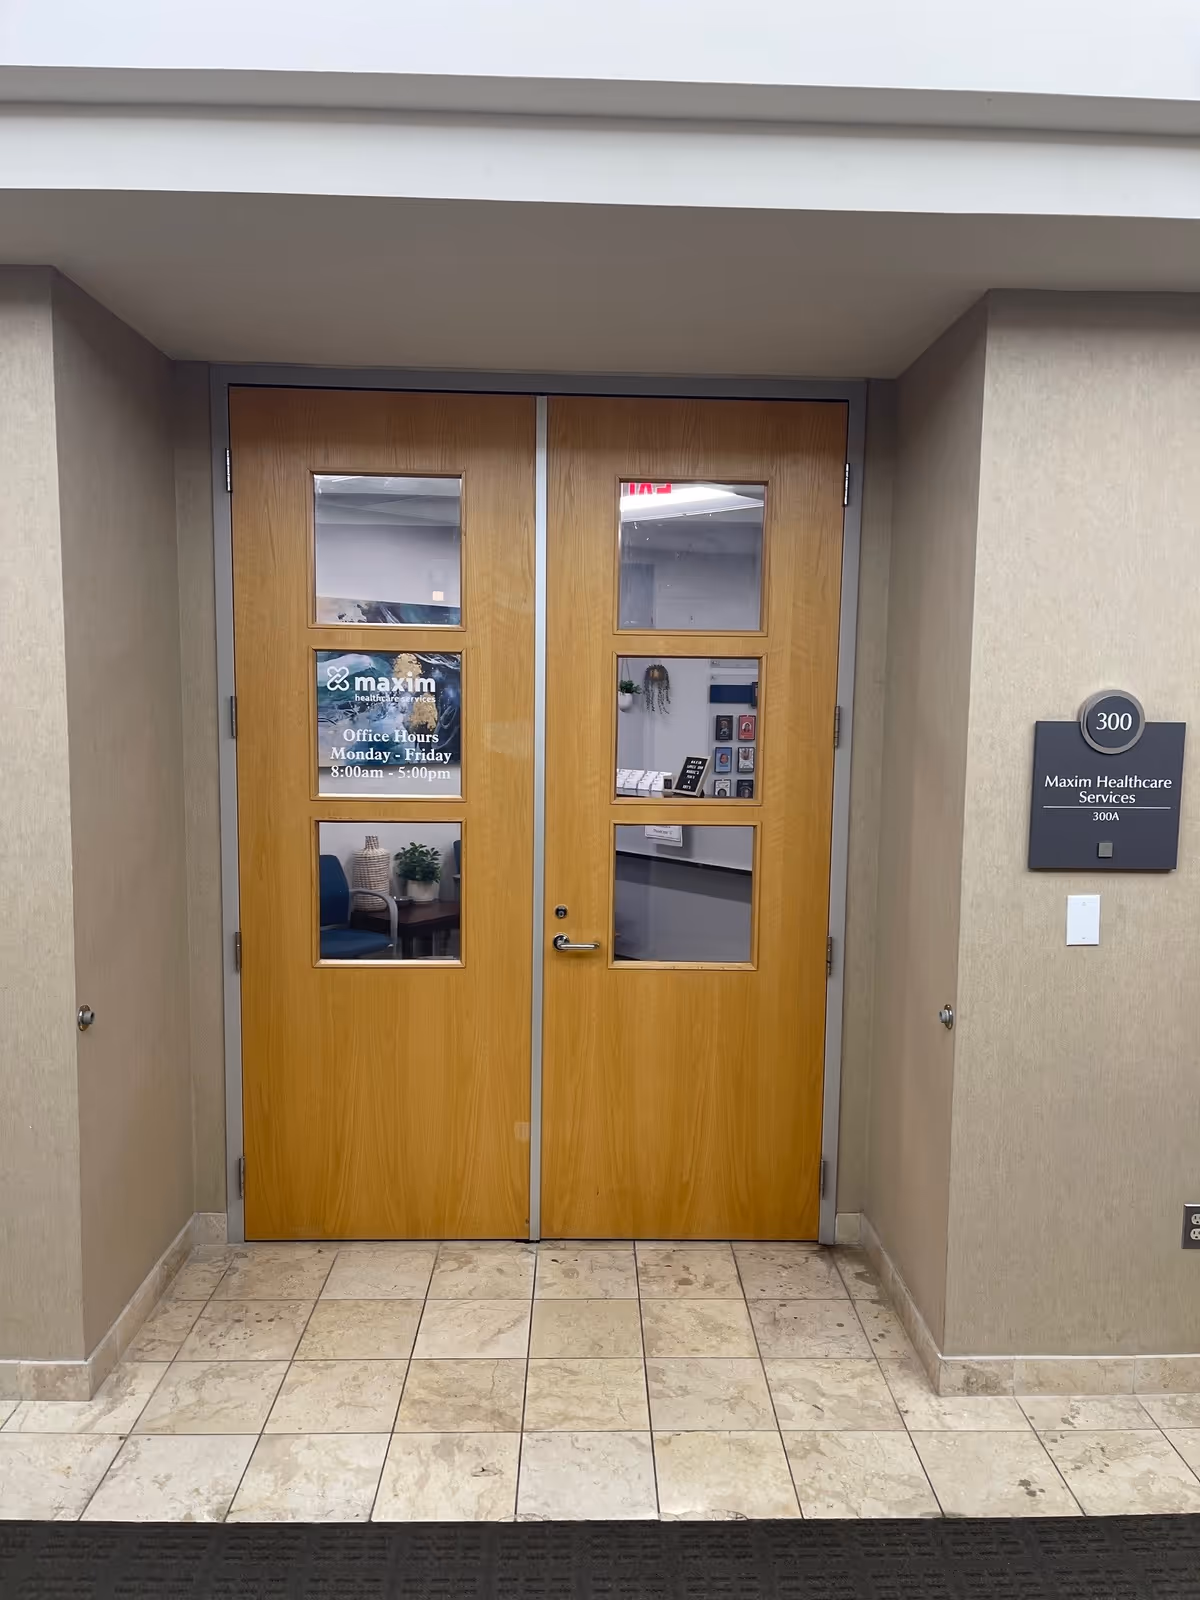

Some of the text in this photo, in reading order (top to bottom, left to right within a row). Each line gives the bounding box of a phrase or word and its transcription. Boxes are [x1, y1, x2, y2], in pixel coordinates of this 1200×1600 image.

[354, 671, 436, 693] maxim
[354, 694, 436, 703] healthcare services
[1096, 712, 1132, 731] 300
[343, 729, 439, 743] Office Hours
[330, 747, 391, 763] Monday
[405, 748, 452, 764] Friday
[331, 766, 384, 778] 8:00am
[398, 767, 451, 782] 5:00pm
[1044, 775, 1172, 789] Maxim Healthcare
[1079, 790, 1136, 804] Services
[1092, 812, 1119, 821] 300A
